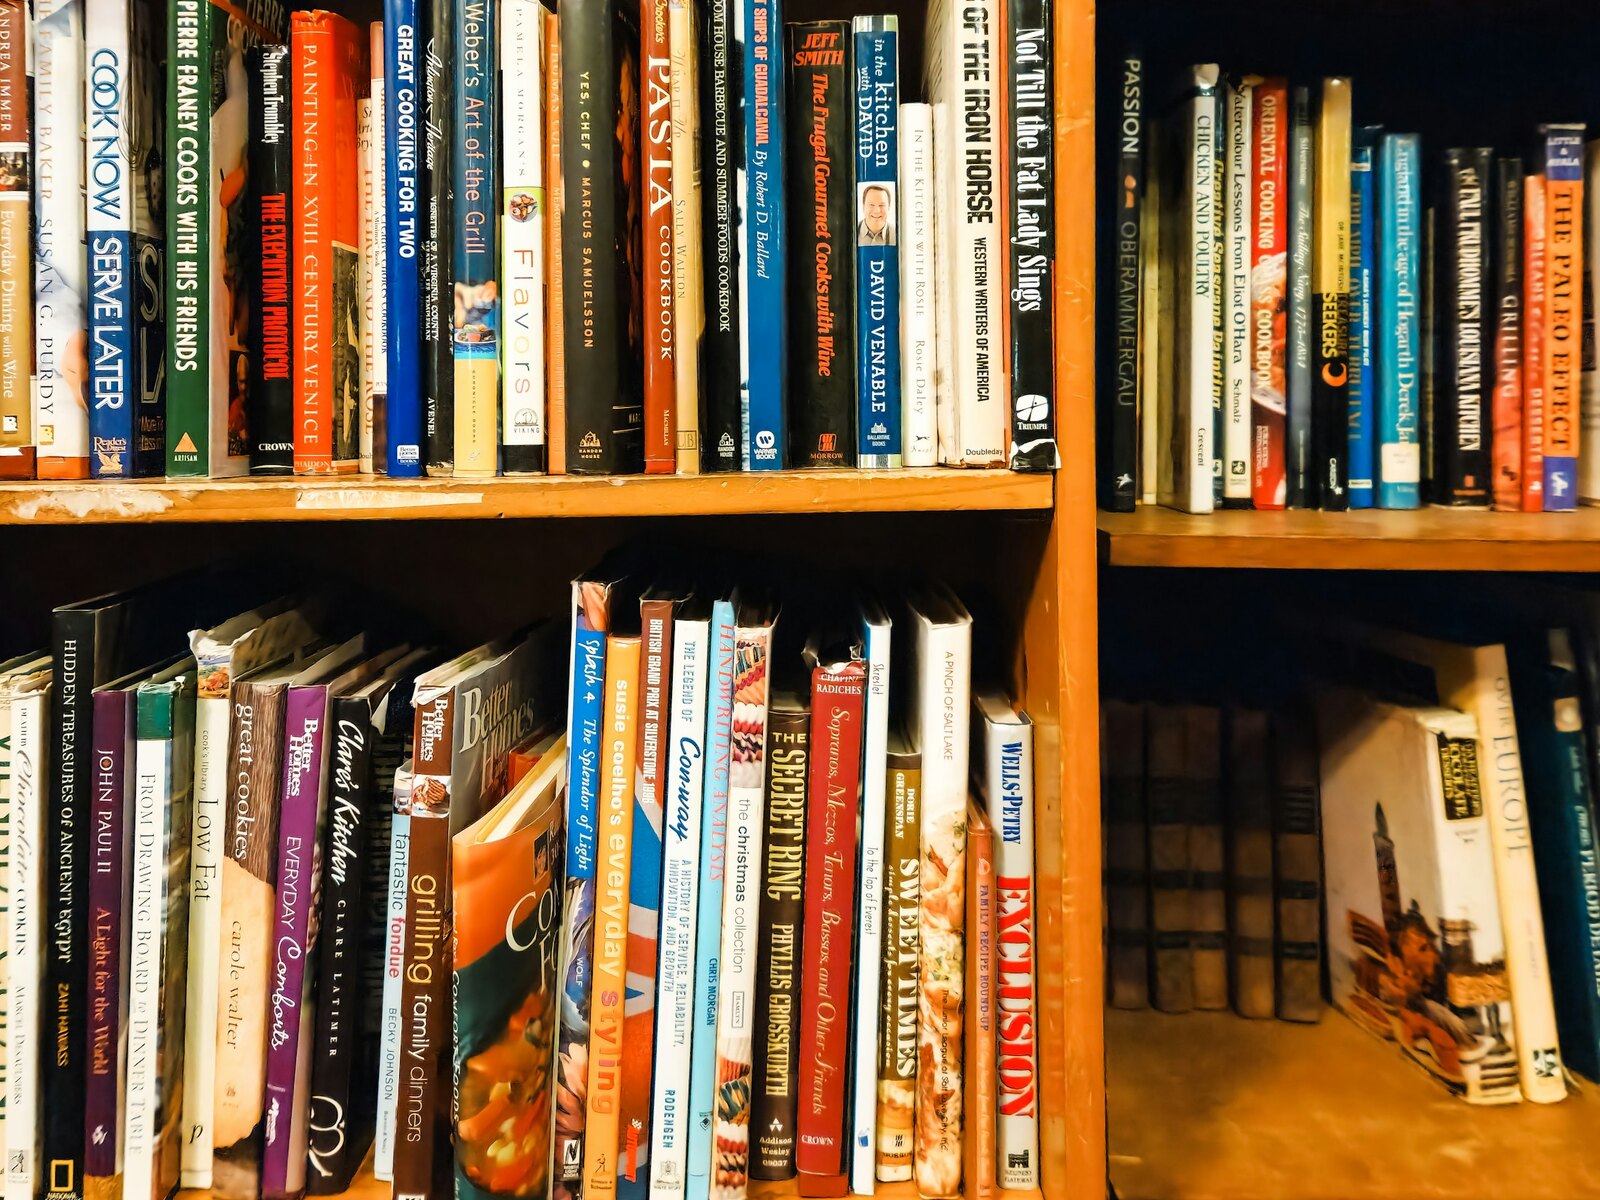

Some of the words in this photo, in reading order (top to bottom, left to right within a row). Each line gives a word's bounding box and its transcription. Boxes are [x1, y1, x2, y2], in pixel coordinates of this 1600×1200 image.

[176, 2, 198, 58] PIERRE
[465, 3, 483, 87] Weber's
[714, 26, 724, 67] HOUSE
[754, 9, 767, 43] SHIPS
[800, 33, 840, 49] JEFF
[875, 40, 885, 53] in
[964, 8, 988, 35] OF
[1016, 28, 1045, 63] Not
[262, 52, 284, 94] Stephen
[397, 24, 414, 84] GREAT
[755, 47, 768, 61] OF
[794, 51, 844, 66] SMITH
[861, 68, 869, 91] with
[875, 56, 885, 76] the
[964, 41, 989, 81] THE
[91, 48, 121, 130] COOK
[177, 65, 198, 131] FRANEY
[302, 45, 318, 152] PAINTING
[466, 98, 483, 130] Art
[580, 72, 590, 106] YES,
[715, 70, 725, 135] BARBECUE
[755, 64, 769, 146] GUADALCANAL
[813, 74, 828, 104] The
[964, 89, 990, 143] IRON
[1016, 69, 1045, 106] Till
[1122, 60, 1140, 153] PASSION
[262, 96, 284, 144] Trombley
[398, 90, 414, 172] COOKING
[466, 139, 483, 157] of
[580, 112, 590, 150] CHEF
[649, 55, 672, 216] PASTA
[810, 106, 829, 162] Frugal
[859, 97, 872, 158] DAVID
[876, 82, 893, 166] kitchen
[1017, 115, 1045, 148] the
[1261, 96, 1275, 175] ORIENTAL
[92, 137, 121, 219] NOW
[177, 138, 198, 204] COOKS
[303, 163, 318, 186] IN
[716, 138, 726, 166] AND
[1017, 157, 1045, 192] Fat
[1196, 115, 1211, 186] CHICKEN
[261, 193, 286, 222] THE
[398, 177, 414, 213] FOR
[466, 168, 483, 201] the
[582, 177, 591, 239] MARCUS
[717, 169, 727, 219] SUMMER
[814, 164, 830, 237] Gourmet
[967, 150, 992, 223] HORSE
[1196, 192, 1211, 224] AND
[1232, 174, 1246, 232] Lessons
[1458, 189, 1480, 219] PAUL
[177, 211, 198, 253] WITH
[303, 196, 318, 245] XVIII
[399, 218, 414, 257] TWO
[466, 211, 485, 253] Grill
[718, 222, 727, 263] FOODS
[1011, 199, 1045, 247] Lady
[1258, 181, 1274, 248] COOKING
[1553, 188, 1573, 243] THE
[38, 219, 54, 293] SUSAN
[93, 237, 123, 320] SERVE
[177, 261, 198, 290] HIS
[262, 226, 286, 301] EXECUTION
[816, 243, 831, 293] Cooks
[974, 237, 987, 284] WESTERN
[1196, 230, 1211, 298] POULTRY
[1233, 236, 1246, 269] from
[302, 255, 318, 354] CENTURY
[582, 248, 593, 348] SAMUELSSON
[660, 226, 670, 360] COOKBOOK
[719, 265, 729, 331] COOKBOOK
[870, 261, 885, 320] DAVID
[975, 288, 987, 336] WRITERS
[1012, 254, 1045, 311] Sings
[1233, 273, 1246, 308] Eliot
[1552, 256, 1571, 341] PALEO
[39, 305, 54, 326] G.
[175, 297, 198, 370] FRIENDS
[514, 249, 533, 394] Flavors
[817, 295, 832, 334] with
[1118, 221, 1136, 406] OBERAMMERGAU
[1233, 313, 1245, 363] O'Hara
[1323, 293, 1337, 358] SEEKERS
[94, 326, 124, 409] LATER
[262, 307, 288, 380] PROTOCOL
[818, 336, 833, 376] Wine
[871, 327, 885, 412] VENABLE
[976, 339, 988, 350] OF
[1257, 310, 1271, 389] COOKBOOK
[1458, 324, 1480, 391] LOUISIANA
[1502, 296, 1517, 397] GRILLING
[40, 338, 54, 415] PURDY
[302, 366, 318, 444] VENICE
[976, 353, 989, 401] AMERICA
[1552, 354, 1570, 449] EFFECT
[1197, 428, 1206, 467] Crescent
[1458, 394, 1480, 450] KITCHEN
[62, 640, 75, 706] HIDDEN
[235, 705, 256, 765] great
[613, 680, 629, 731] susie
[60, 710, 74, 802] TREASURES
[335, 720, 364, 791] Clare's
[773, 732, 807, 743] THE
[98, 749, 114, 800] JOHN
[610, 741, 627, 825] coelho's
[770, 750, 806, 841] SECRET
[1002, 742, 1023, 845] WELLS-PETRY
[1493, 735, 1528, 858] EUROPE
[61, 807, 74, 826] OF
[98, 811, 113, 855] PAUL
[196, 799, 218, 851] Low
[234, 772, 256, 860] cookies
[739, 799, 751, 821] the
[895, 773, 905, 838] GREENSPAN
[906, 788, 914, 824] DORIE
[59, 831, 73, 905] ANCIENT
[98, 861, 113, 873] II
[330, 797, 365, 885] Kitchen
[736, 826, 748, 902] christmas
[194, 863, 216, 902] Fat
[281, 836, 301, 929] EVERYDAY
[391, 834, 410, 910] fantastic
[768, 848, 802, 899] RING
[334, 900, 345, 960] CLARE
[410, 875, 440, 983] grilling
[599, 834, 629, 977] everyday
[898, 859, 919, 951] SWEET
[389, 917, 406, 978] fondue
[733, 908, 746, 973] collection
[770, 924, 794, 988] PHYLLIS
[270, 936, 301, 1050] Comforts
[708, 958, 718, 984] CHRIS
[997, 875, 1034, 1117] EXCLUSION
[329, 974, 342, 1057] LATIMER
[388, 1008, 397, 1045] BECKY
[409, 994, 432, 1060] family
[706, 986, 717, 1026] MORGAN
[896, 964, 917, 1077] TIMES
[385, 1049, 396, 1099] JOHNSON
[593, 990, 620, 1114] styling
[765, 994, 791, 1095] GROSSKURTH
[407, 1066, 428, 1142] dinners
[662, 1090, 675, 1148] RODENGEN
[800, 1136, 834, 1145] CROWN
